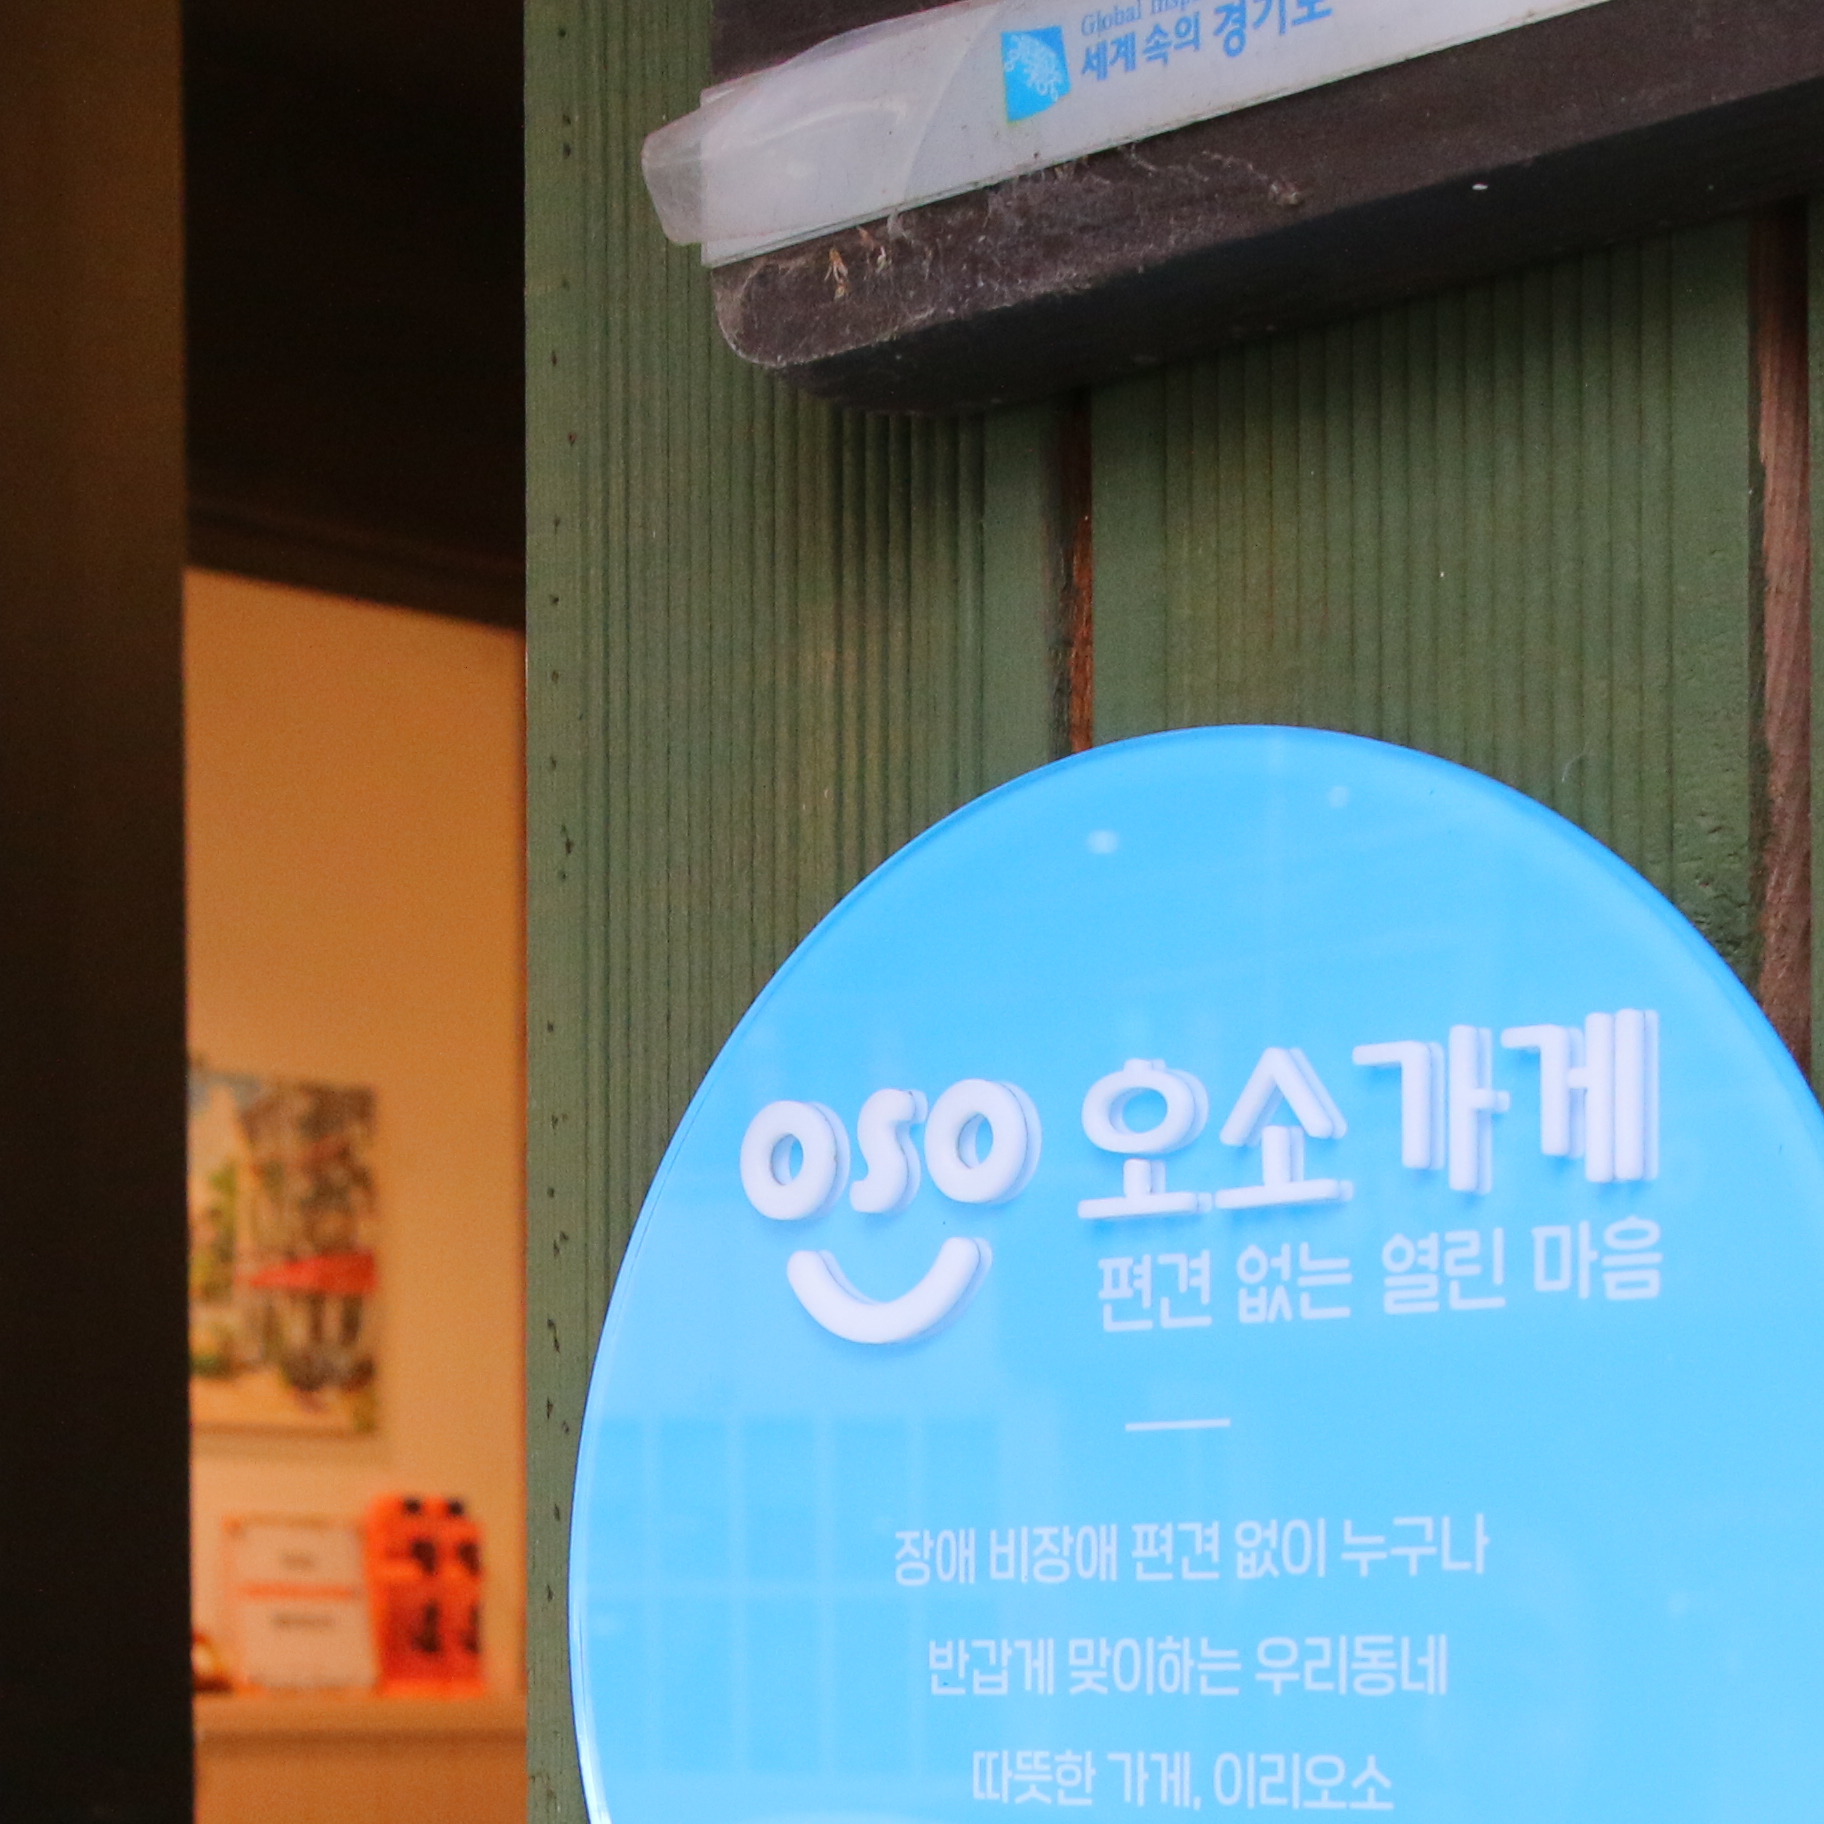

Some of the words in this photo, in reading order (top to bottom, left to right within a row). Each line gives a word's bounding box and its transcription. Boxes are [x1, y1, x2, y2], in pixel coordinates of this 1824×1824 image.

[1080, 32, 1136, 81] 세계
[1142, 12, 1200, 66] 속의
[1097, 1248, 1212, 1333] 편견
[1236, 1241, 1352, 1323] 없는
[1382, 1226, 1506, 1316] 열린
[1531, 1215, 1663, 1303] 마음
[893, 1527, 976, 1587] 장애
[988, 1523, 1118, 1586] 비장애
[1131, 1521, 1220, 1583] 편견
[1234, 1518, 1327, 1580] 없이
[1340, 1512, 1490, 1577] 누구나
[928, 1637, 1055, 1697] 반갑게
[1067, 1635, 1242, 1697] 맞이하는
[1255, 1633, 1448, 1697] 우리동네
[971, 1748, 1096, 1806] 따뜻한
[1106, 1750, 1202, 1810] 가게,
[1213, 1751, 1394, 1811] 이리오소
